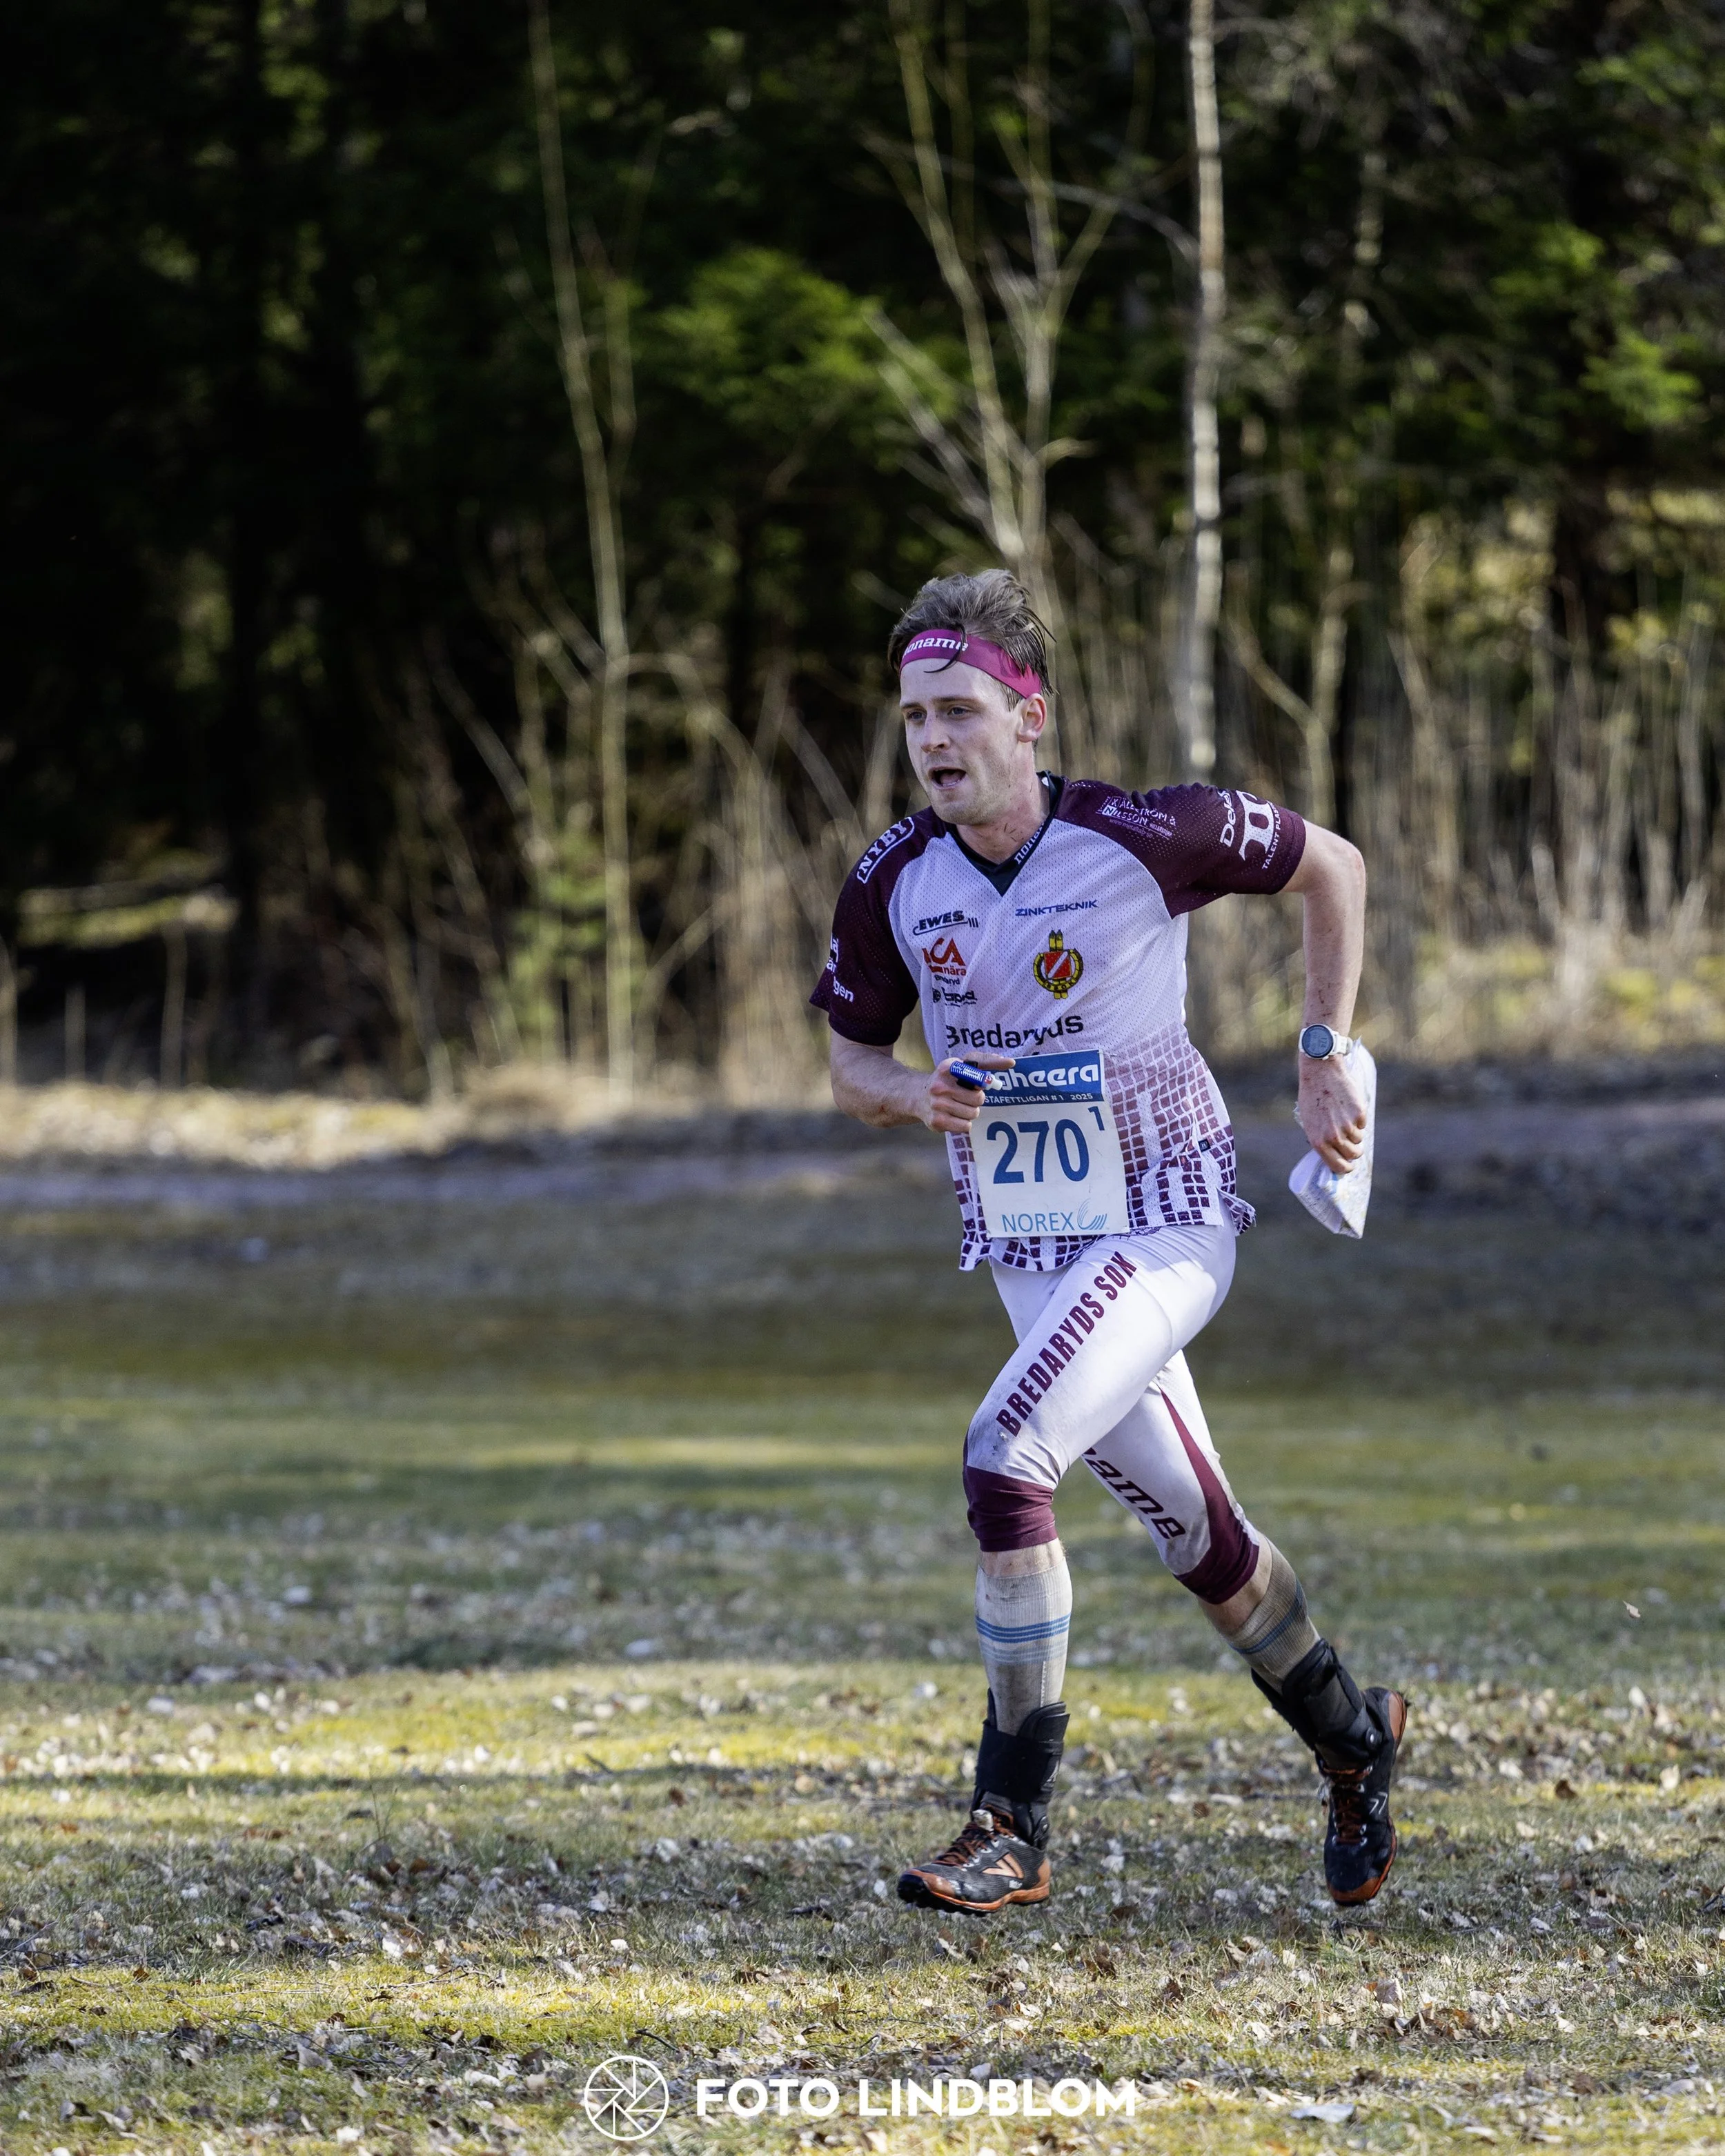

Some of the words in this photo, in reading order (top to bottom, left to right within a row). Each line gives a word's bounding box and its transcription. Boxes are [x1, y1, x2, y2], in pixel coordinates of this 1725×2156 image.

[858, 821, 907, 873] NYBY
[1261, 832, 1280, 869] TALENT
[918, 910, 965, 931] EWES
[1015, 900, 1098, 917] ZINKTEKNIK
[943, 965, 967, 976] nära
[994, 1064, 1099, 1091] gheera
[984, 1094, 1049, 1104] STAFETTLIGAN
[1070, 1093, 1094, 1101] 2025
[986, 1118, 1090, 1185] 270
[1087, 1105, 1105, 1131] 1
[1002, 1211, 1075, 1232] NOREX
[996, 1292, 1105, 1438] BREDARYDS
[1094, 1250, 1137, 1301] SOK
